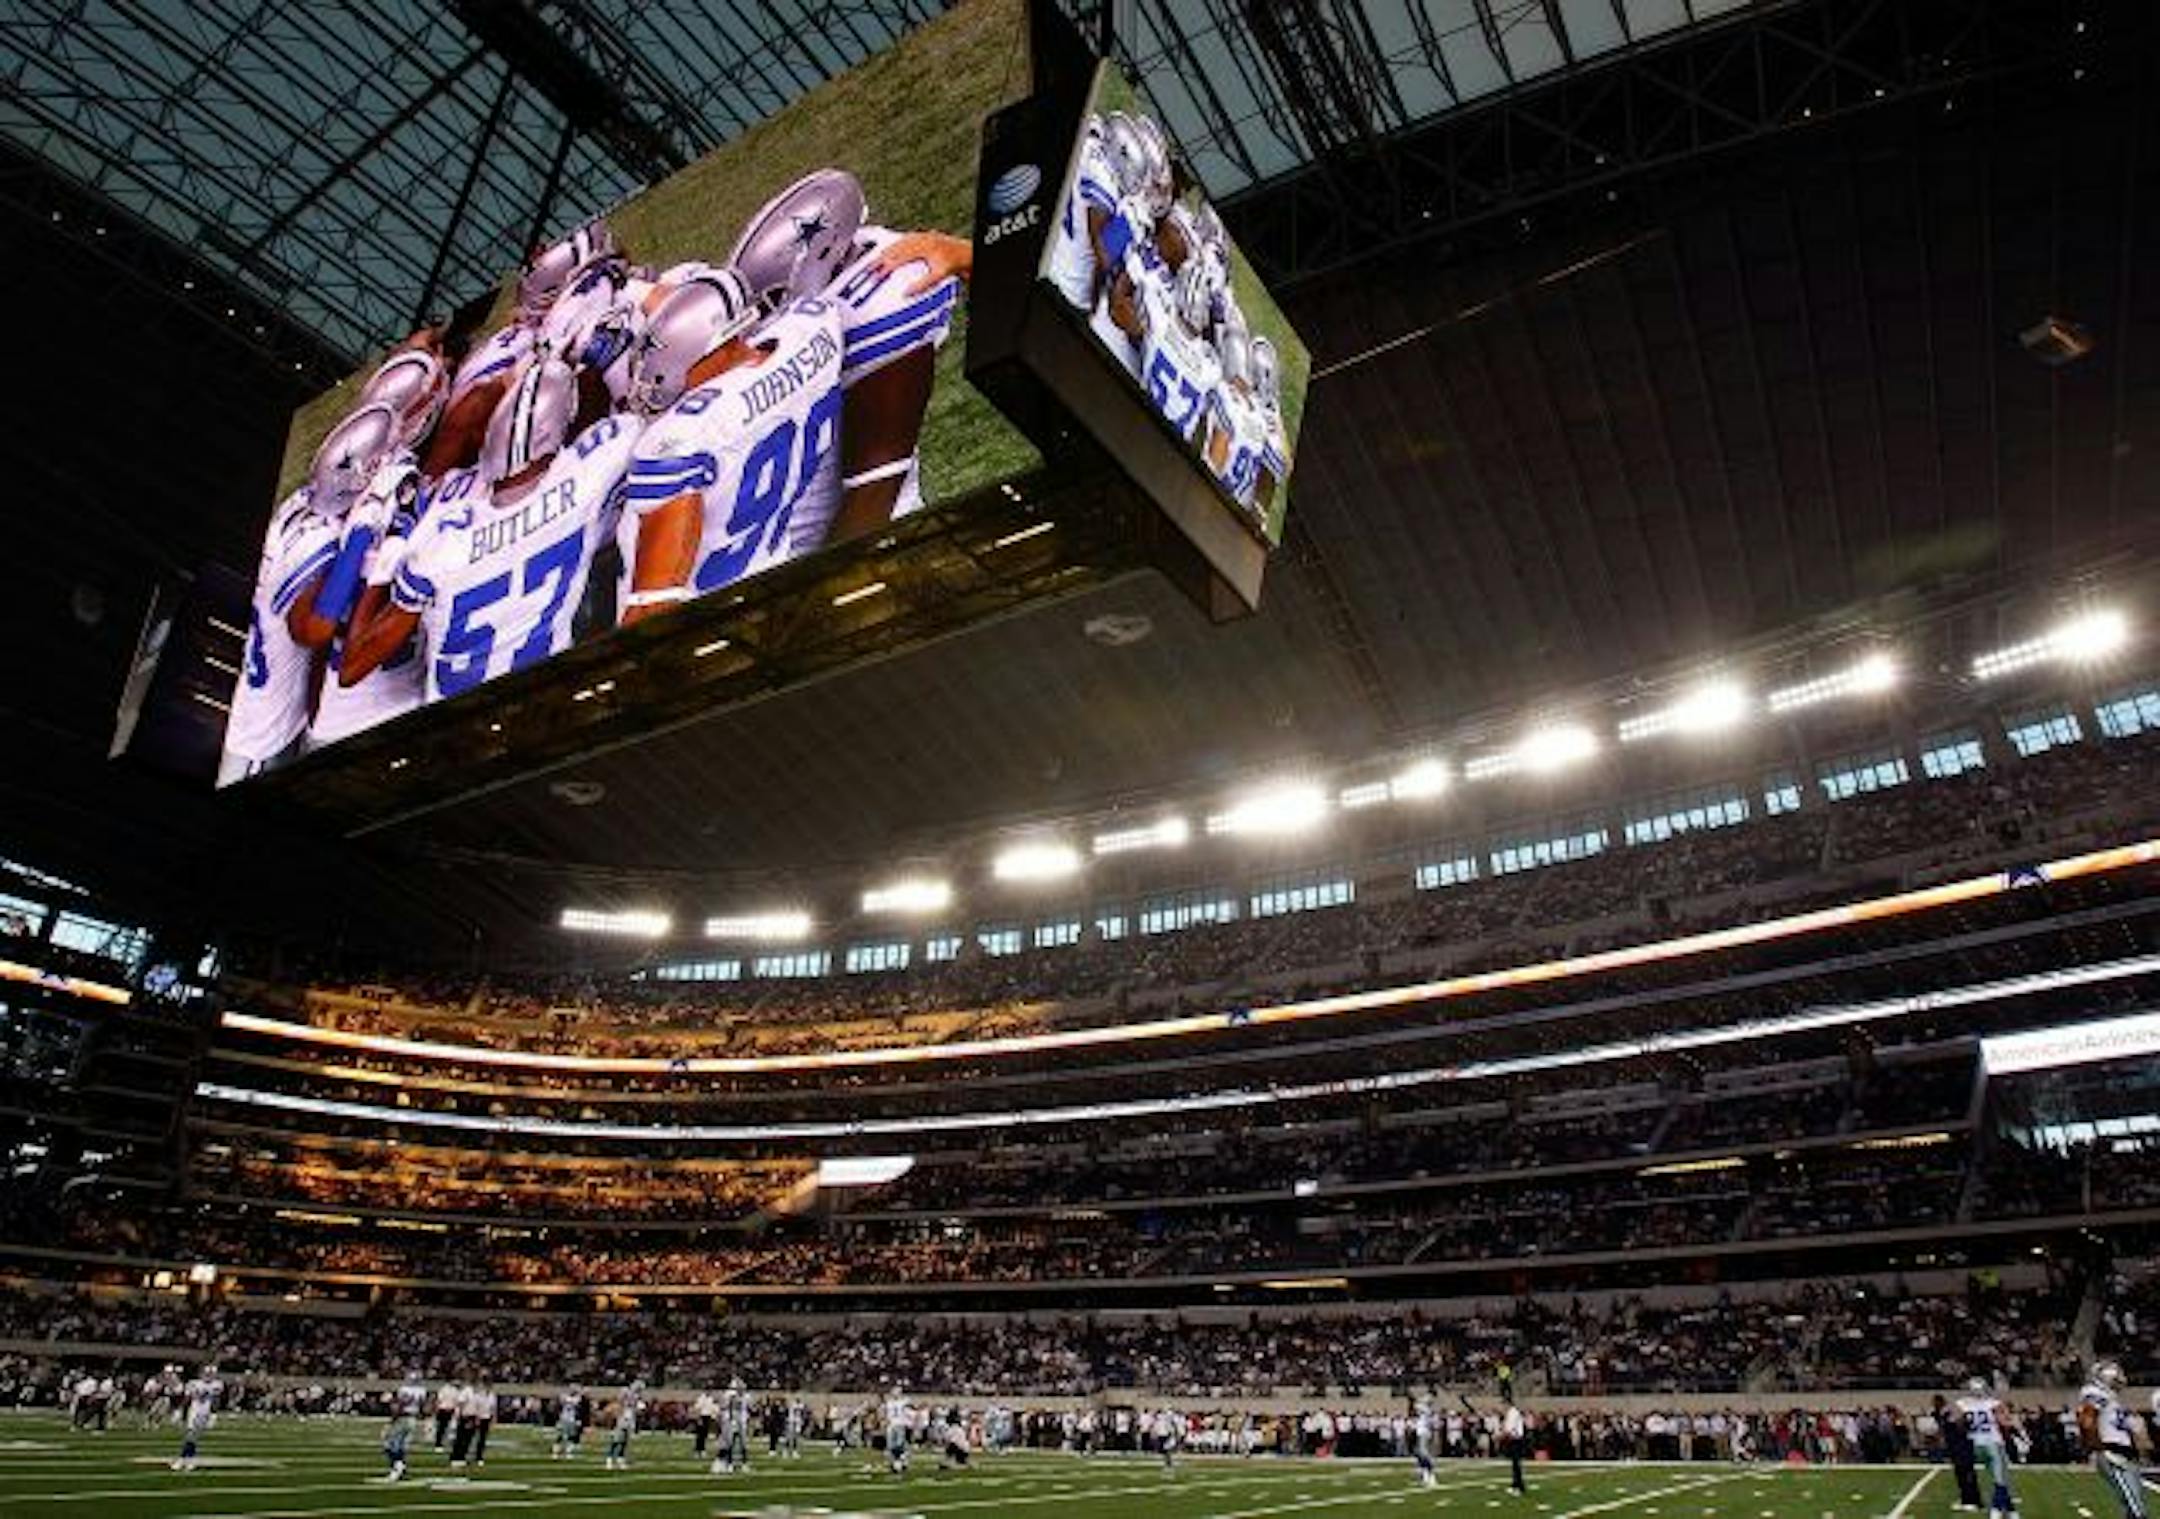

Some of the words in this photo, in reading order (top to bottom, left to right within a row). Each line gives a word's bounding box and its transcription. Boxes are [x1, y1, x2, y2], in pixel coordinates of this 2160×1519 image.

[984, 204, 1041, 246] at&t
[739, 327, 838, 424] JOHNSON
[470, 478, 577, 563] BUTLER
[437, 523, 585, 695] 57
